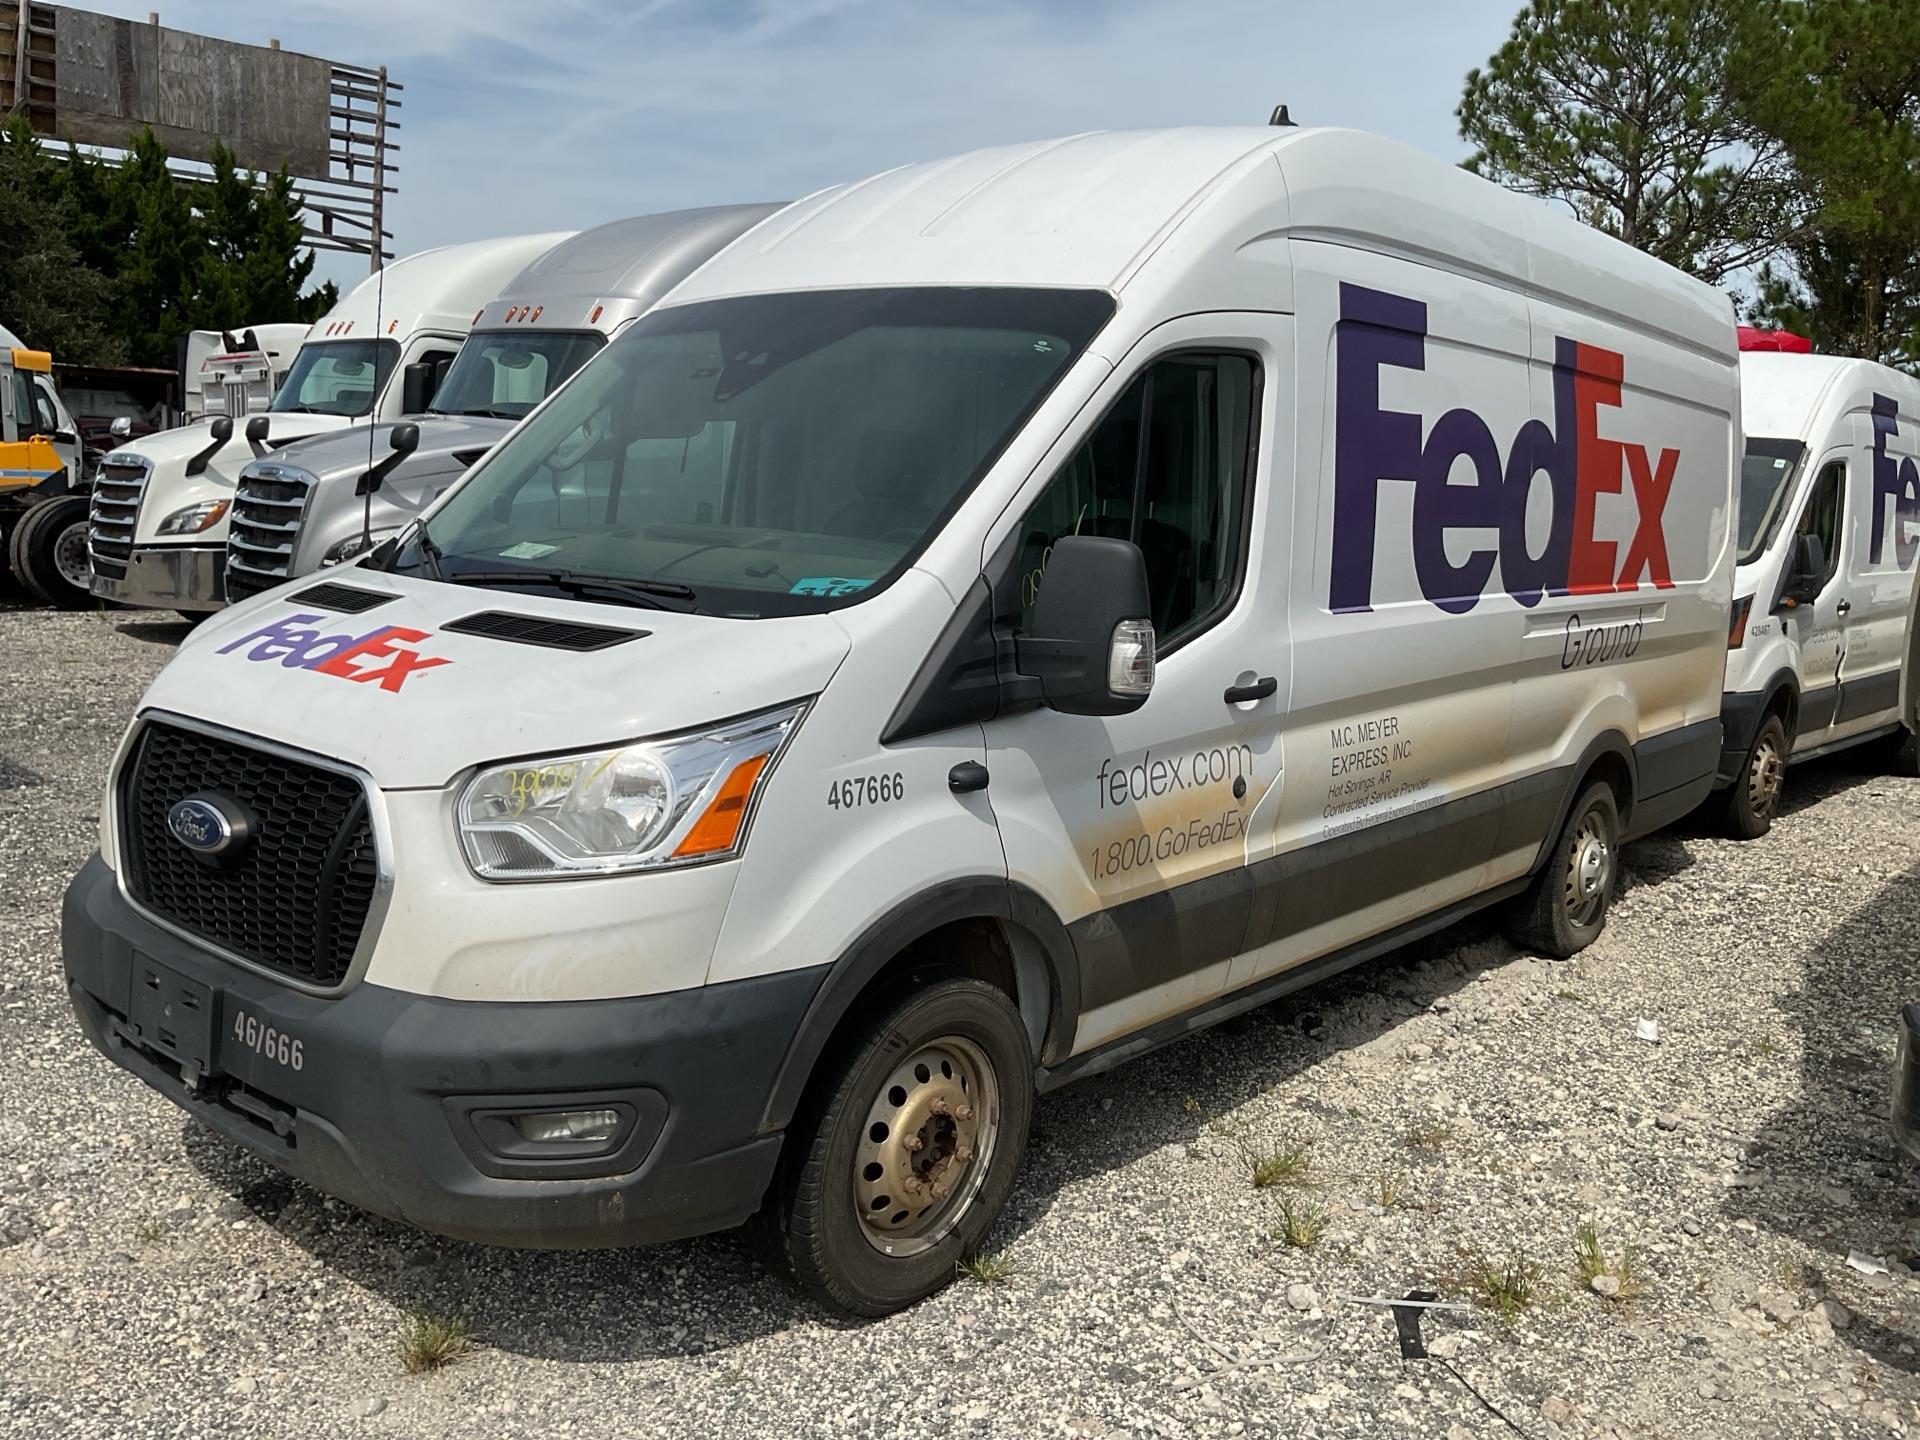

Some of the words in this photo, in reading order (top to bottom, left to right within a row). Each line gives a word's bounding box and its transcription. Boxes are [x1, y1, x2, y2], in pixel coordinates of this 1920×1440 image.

[1329, 281, 1681, 615] FedEx
[215, 614, 455, 693] FedEx
[1561, 608, 1643, 669] Ground
[1331, 726, 1355, 748] M.C.
[1358, 717, 1399, 743] MEYER
[828, 772, 903, 810] 467666
[1096, 744, 1252, 809] fedex.com
[1328, 781, 1342, 799] Hot
[1378, 770, 1391, 785] AR
[176, 807, 210, 841] Ford
[1323, 796, 1369, 819] Contracted
[1370, 787, 1398, 805] Service
[1092, 810, 1248, 880] 1.800.GoFedEx
